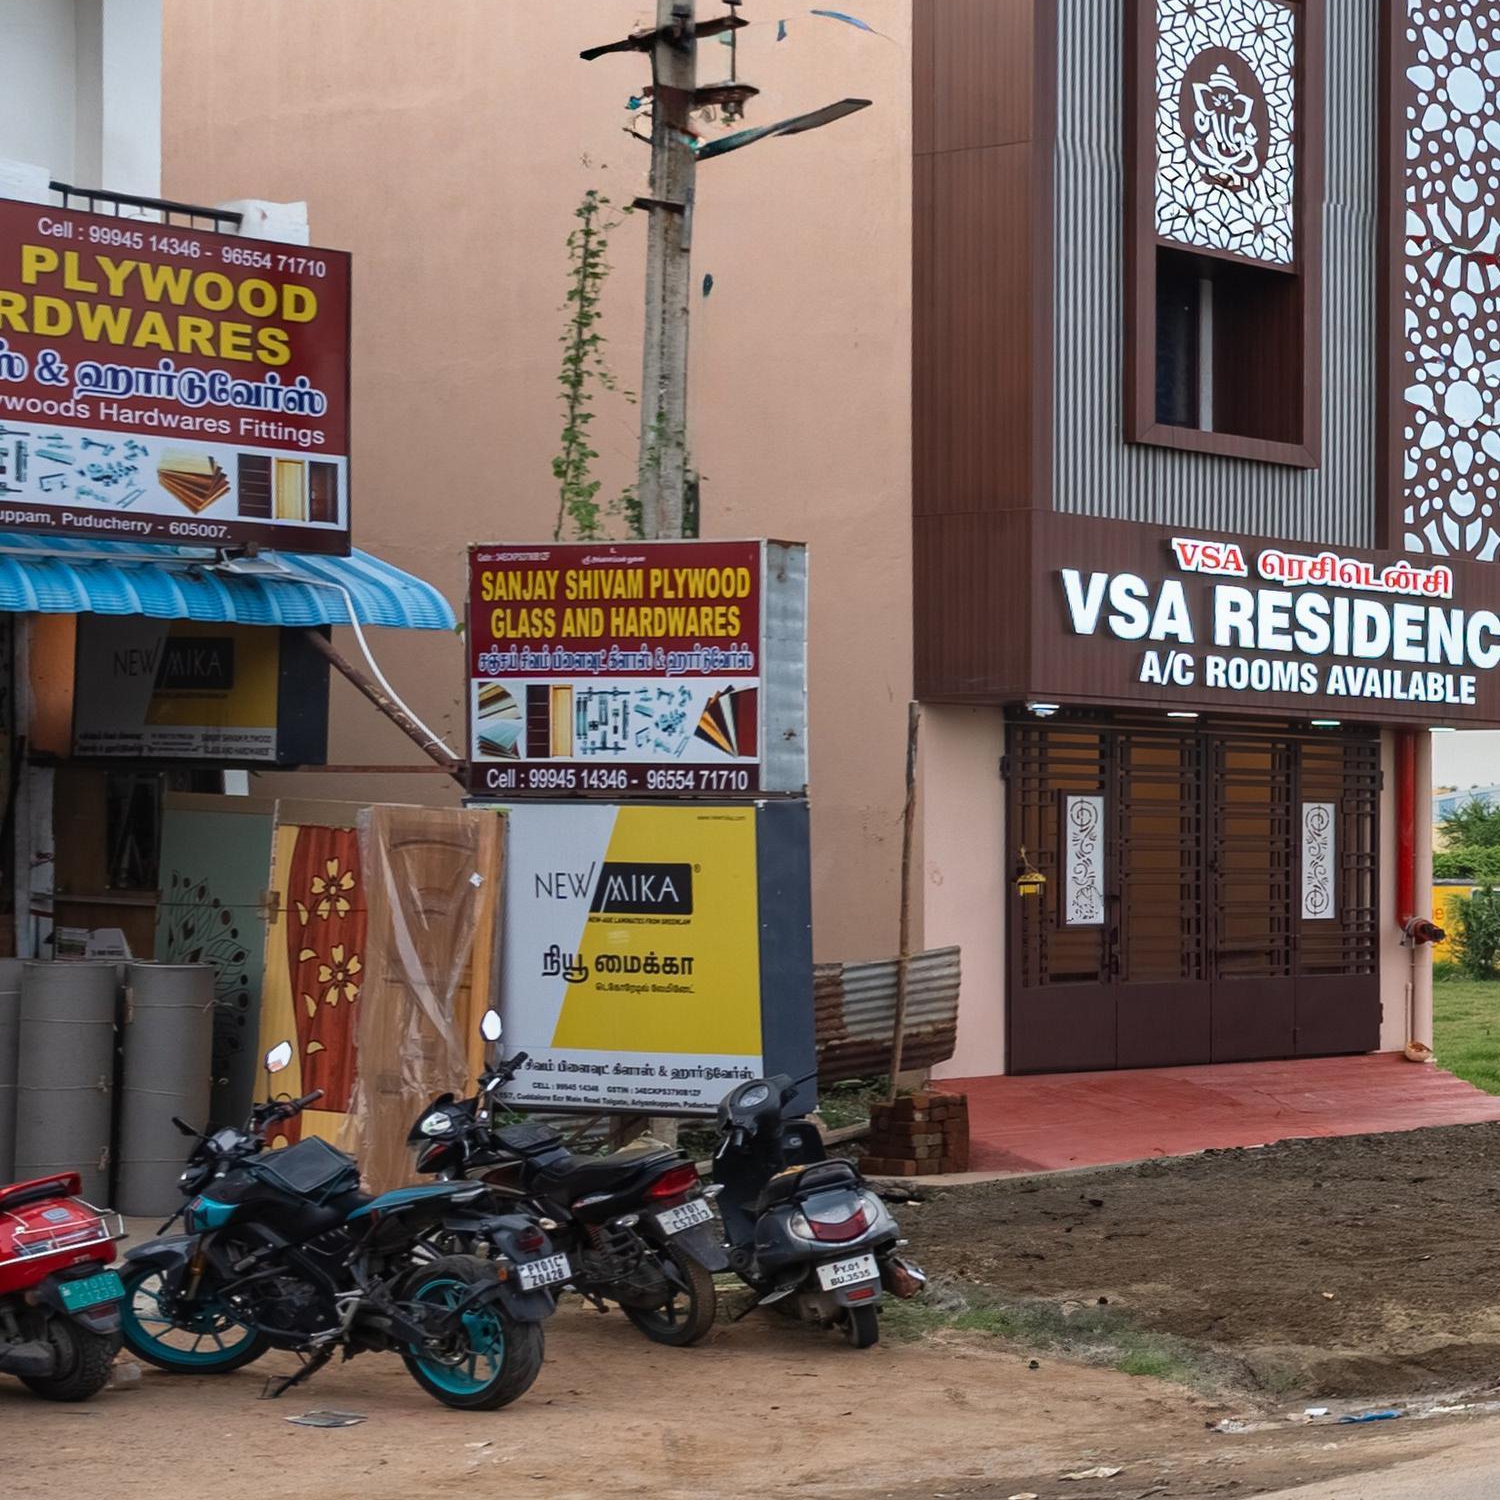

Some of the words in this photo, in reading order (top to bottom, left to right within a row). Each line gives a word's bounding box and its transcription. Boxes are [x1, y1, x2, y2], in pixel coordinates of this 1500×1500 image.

[38, 217, 72, 240] Cell
[88, 226, 143, 250] 99945
[149, 236, 200, 258] 14346
[221, 247, 272, 270] 96554
[277, 255, 326, 278] 71710
[21, 244, 317, 323] PLYWOOD
[35, 350, 69, 387] &
[74, 359, 328, 418] ஹார்டுவேர்ஸ்
[100, 402, 231, 435] Hardwares
[240, 418, 326, 447] Fittings
[62, 512, 152, 535] Puducherry
[169, 521, 232, 539] 605007.
[1172, 537, 1248, 576] VSA
[481, 570, 560, 601] SANJAY
[565, 568, 643, 599] SHIVAM
[650, 567, 750, 598] PLYWOOD
[491, 608, 556, 638] GLASS
[562, 607, 604, 638] AND
[611, 606, 741, 637] HARDWARES
[1061, 568, 1195, 644] VSA
[113, 637, 160, 676] NEW
[164, 651, 223, 688] MIKA
[1140, 651, 1194, 686] A/C
[1206, 656, 1318, 694] ROOMS
[1326, 666, 1476, 705] AVAILABLE
[487, 768, 516, 789] Cell
[529, 769, 576, 789] 99945
[580, 769, 627, 790] 14346
[647, 770, 694, 790] 96554
[699, 770, 748, 790] 71710
[535, 861, 596, 899] NEW
[600, 874, 680, 913] MIKA
[542, 944, 589, 984] நியூ
[595, 951, 694, 976] மைக்கா
[532, 1082, 550, 1090] CELL
[658, 1065, 667, 1077] &
